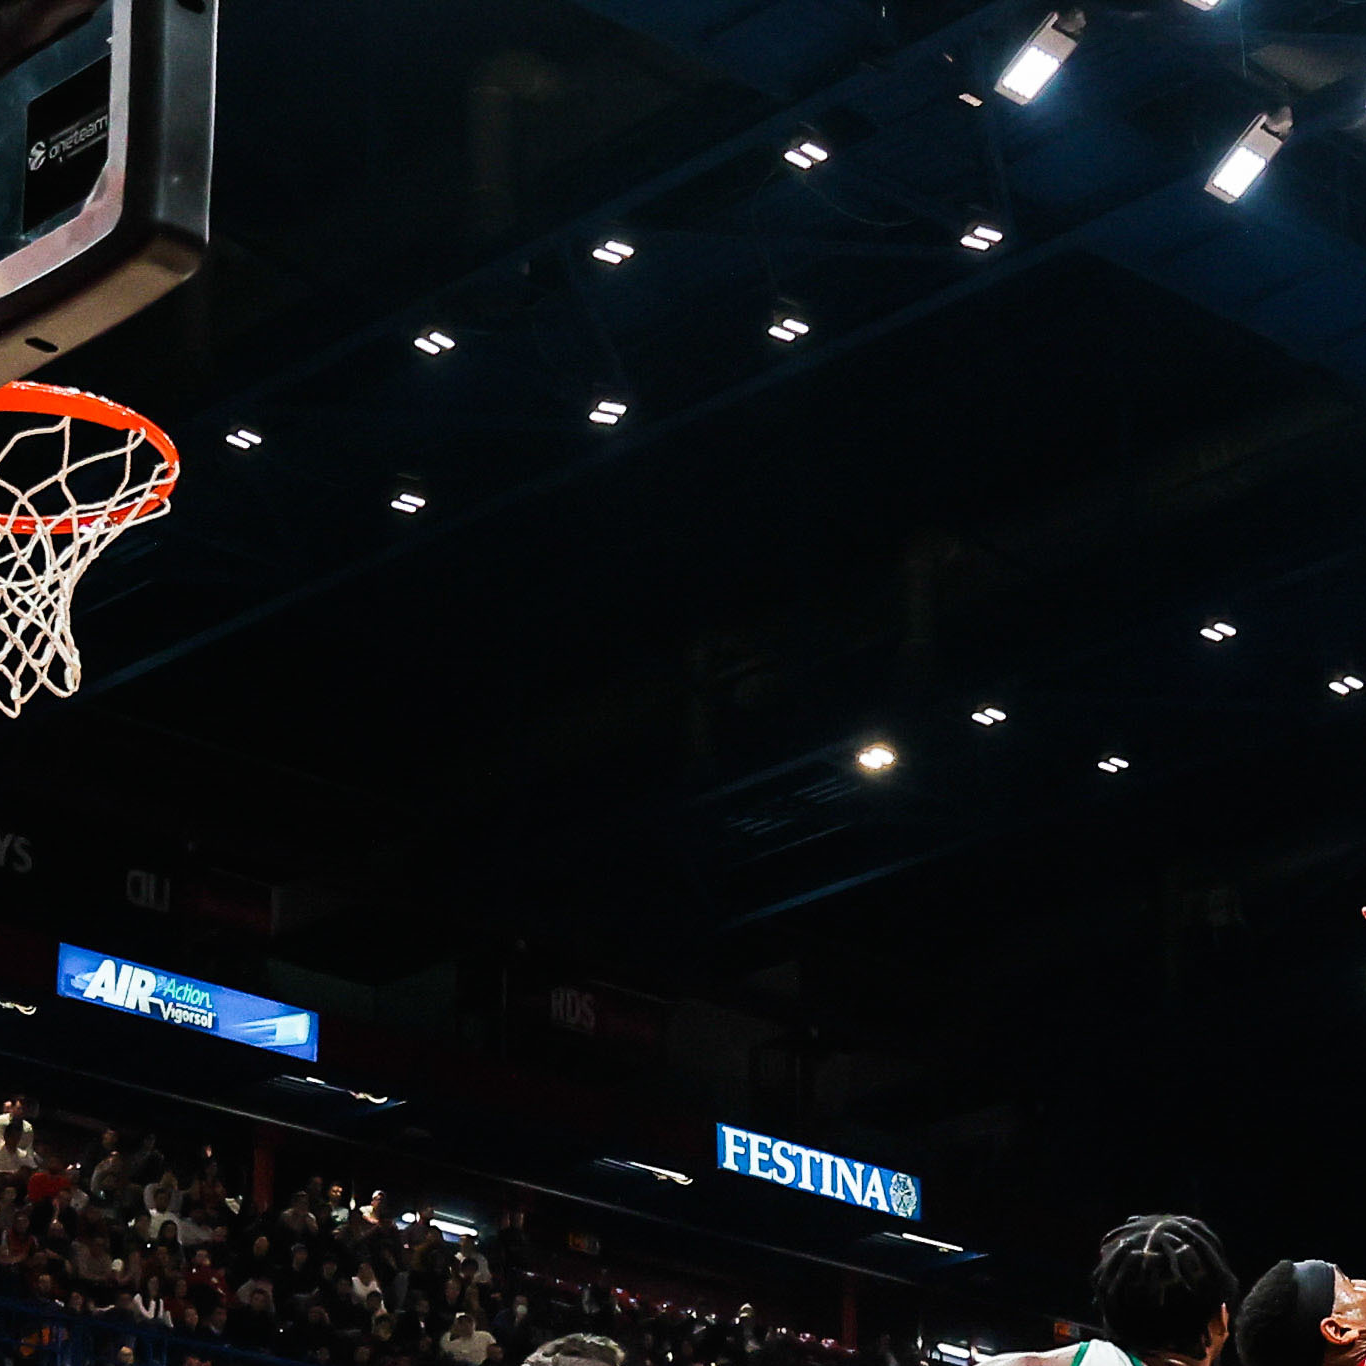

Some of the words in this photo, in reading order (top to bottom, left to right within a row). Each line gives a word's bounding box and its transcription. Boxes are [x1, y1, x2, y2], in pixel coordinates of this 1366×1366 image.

[83, 958, 157, 1014] AIR
[162, 977, 214, 1009] Action
[156, 1000, 215, 1029] Vigorsol
[721, 1124, 891, 1213] FESTINA
